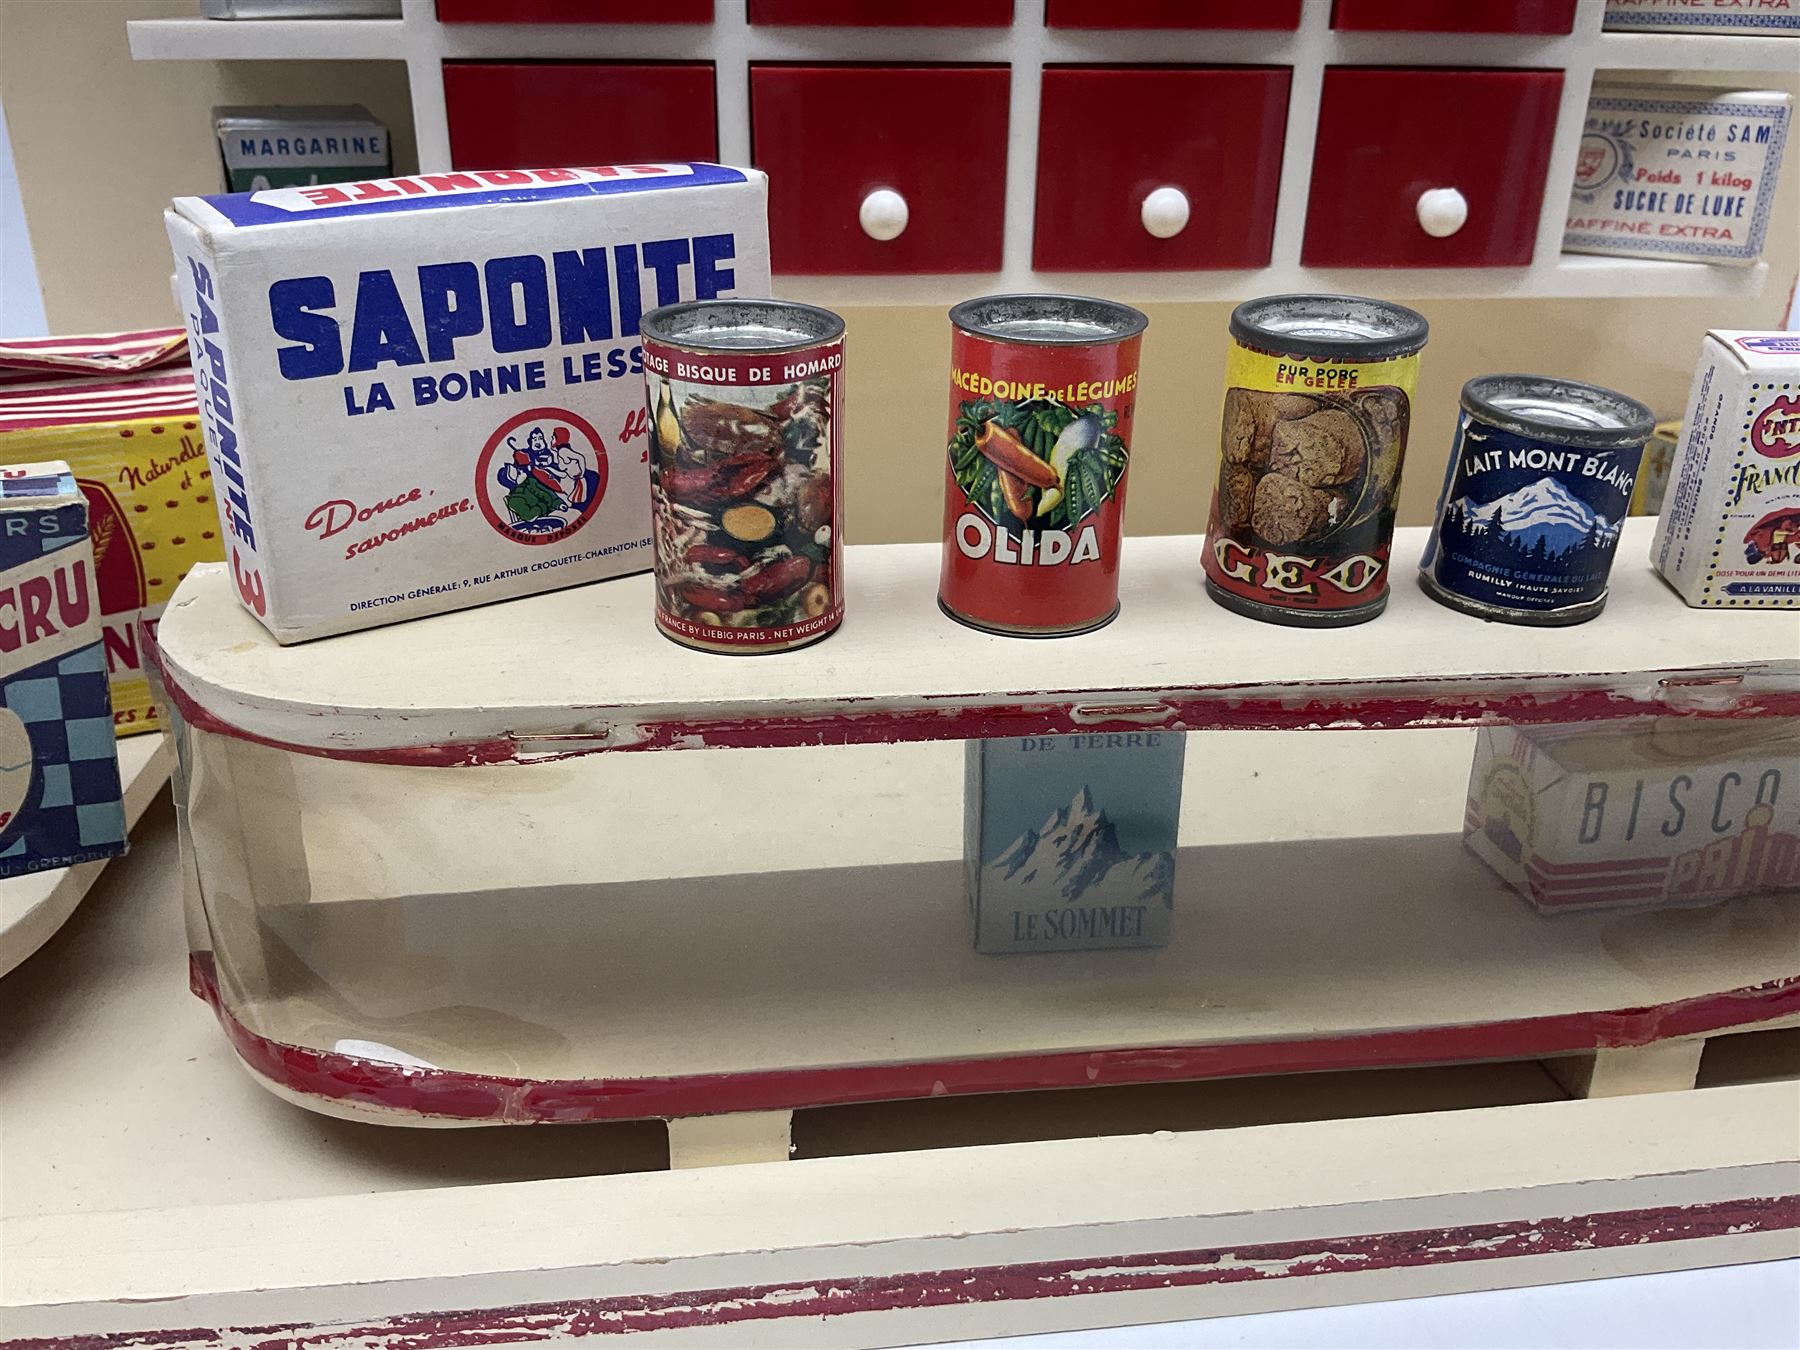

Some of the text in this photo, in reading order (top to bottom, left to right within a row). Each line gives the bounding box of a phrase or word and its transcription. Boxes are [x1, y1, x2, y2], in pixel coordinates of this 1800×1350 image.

[240, 136, 381, 156] MARGARINE
[1640, 120, 1717, 142] Société
[1728, 124, 1772, 145] SAM
[1667, 148, 1737, 162] PARIS
[298, 163, 670, 207] SAPONITE
[1635, 166, 1682, 185] Poids
[1711, 170, 1753, 191] kilog
[1613, 189, 1747, 219] SUCRE DE LUXE
[1659, 224, 1734, 241] EXTRA
[268, 233, 736, 381] SAPONITE
[676, 362, 738, 382] BISQUE
[749, 367, 771, 382] DE
[784, 353, 842, 380] HOMARD
[1275, 372, 1295, 385] EN
[1277, 363, 1359, 380] PUR PORC
[189, 312, 224, 475] PAQUET
[344, 381, 396, 417] LA
[412, 360, 546, 407] BONNE
[1066, 370, 1138, 402] LÉGUMES
[187, 255, 258, 553] SAPONITE
[1464, 448, 1634, 496] LAIT MONT BLANC
[1701, 446, 1711, 473] PRIX
[181, 470, 193, 490] et
[1684, 478, 1703, 541] BRUXELLES
[496, 522, 537, 544] MARQUE
[955, 512, 1101, 567] OLIDA
[1213, 537, 1385, 594] GEO
[1451, 551, 1511, 577] COMPAGNIE
[1572, 575, 1585, 584] DU
[1585, 573, 1602, 583] LAIT
[1468, 570, 1514, 588] RUMILLY
[232, 544, 267, 618] 3
[349, 593, 405, 612] DIRECTION
[473, 575, 491, 586] RUE
[493, 565, 530, 581] ARTHUR
[1748, 585, 1761, 593] LA
[0, 559, 91, 654] CRU
[661, 611, 687, 632] FRANCE
[688, 625, 701, 636] BY
[702, 628, 735, 640] LIEBIG
[736, 631, 766, 640] PARIS
[774, 628, 794, 639] NET
[795, 615, 828, 635] WEIGHT
[1021, 733, 1162, 752] DE TERRE
[1043, 905, 1147, 940] SOMMET
